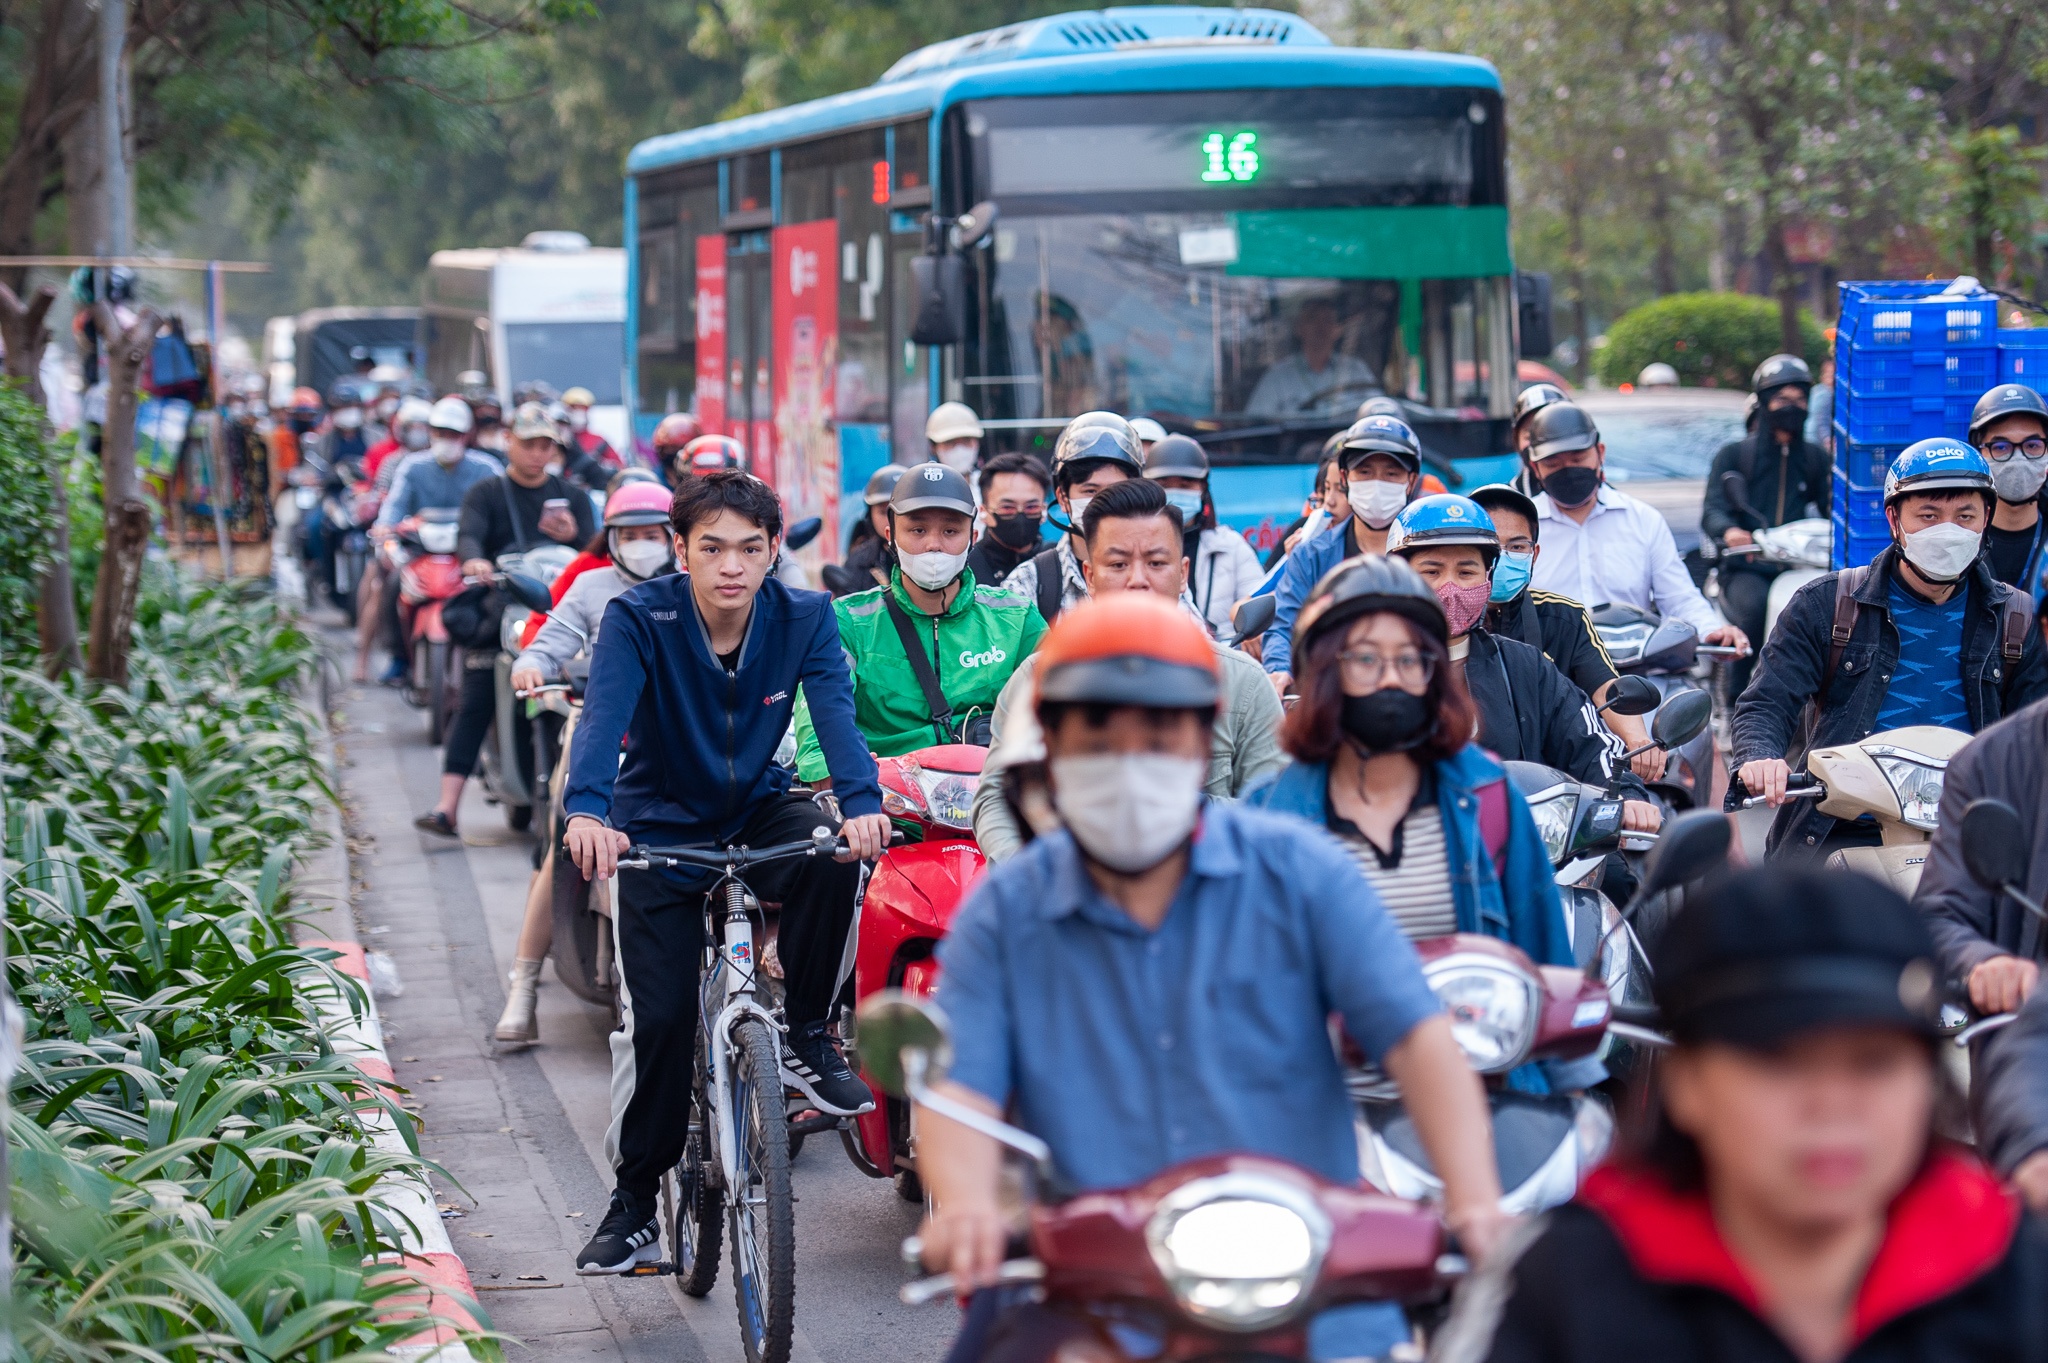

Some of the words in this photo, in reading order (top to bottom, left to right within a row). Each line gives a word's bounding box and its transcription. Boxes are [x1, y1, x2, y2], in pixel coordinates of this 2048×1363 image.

[1201, 132, 1259, 182] 16
[1925, 446, 1965, 459] beko
[958, 645, 1007, 668] Grab
[941, 844, 982, 855] HONDA
